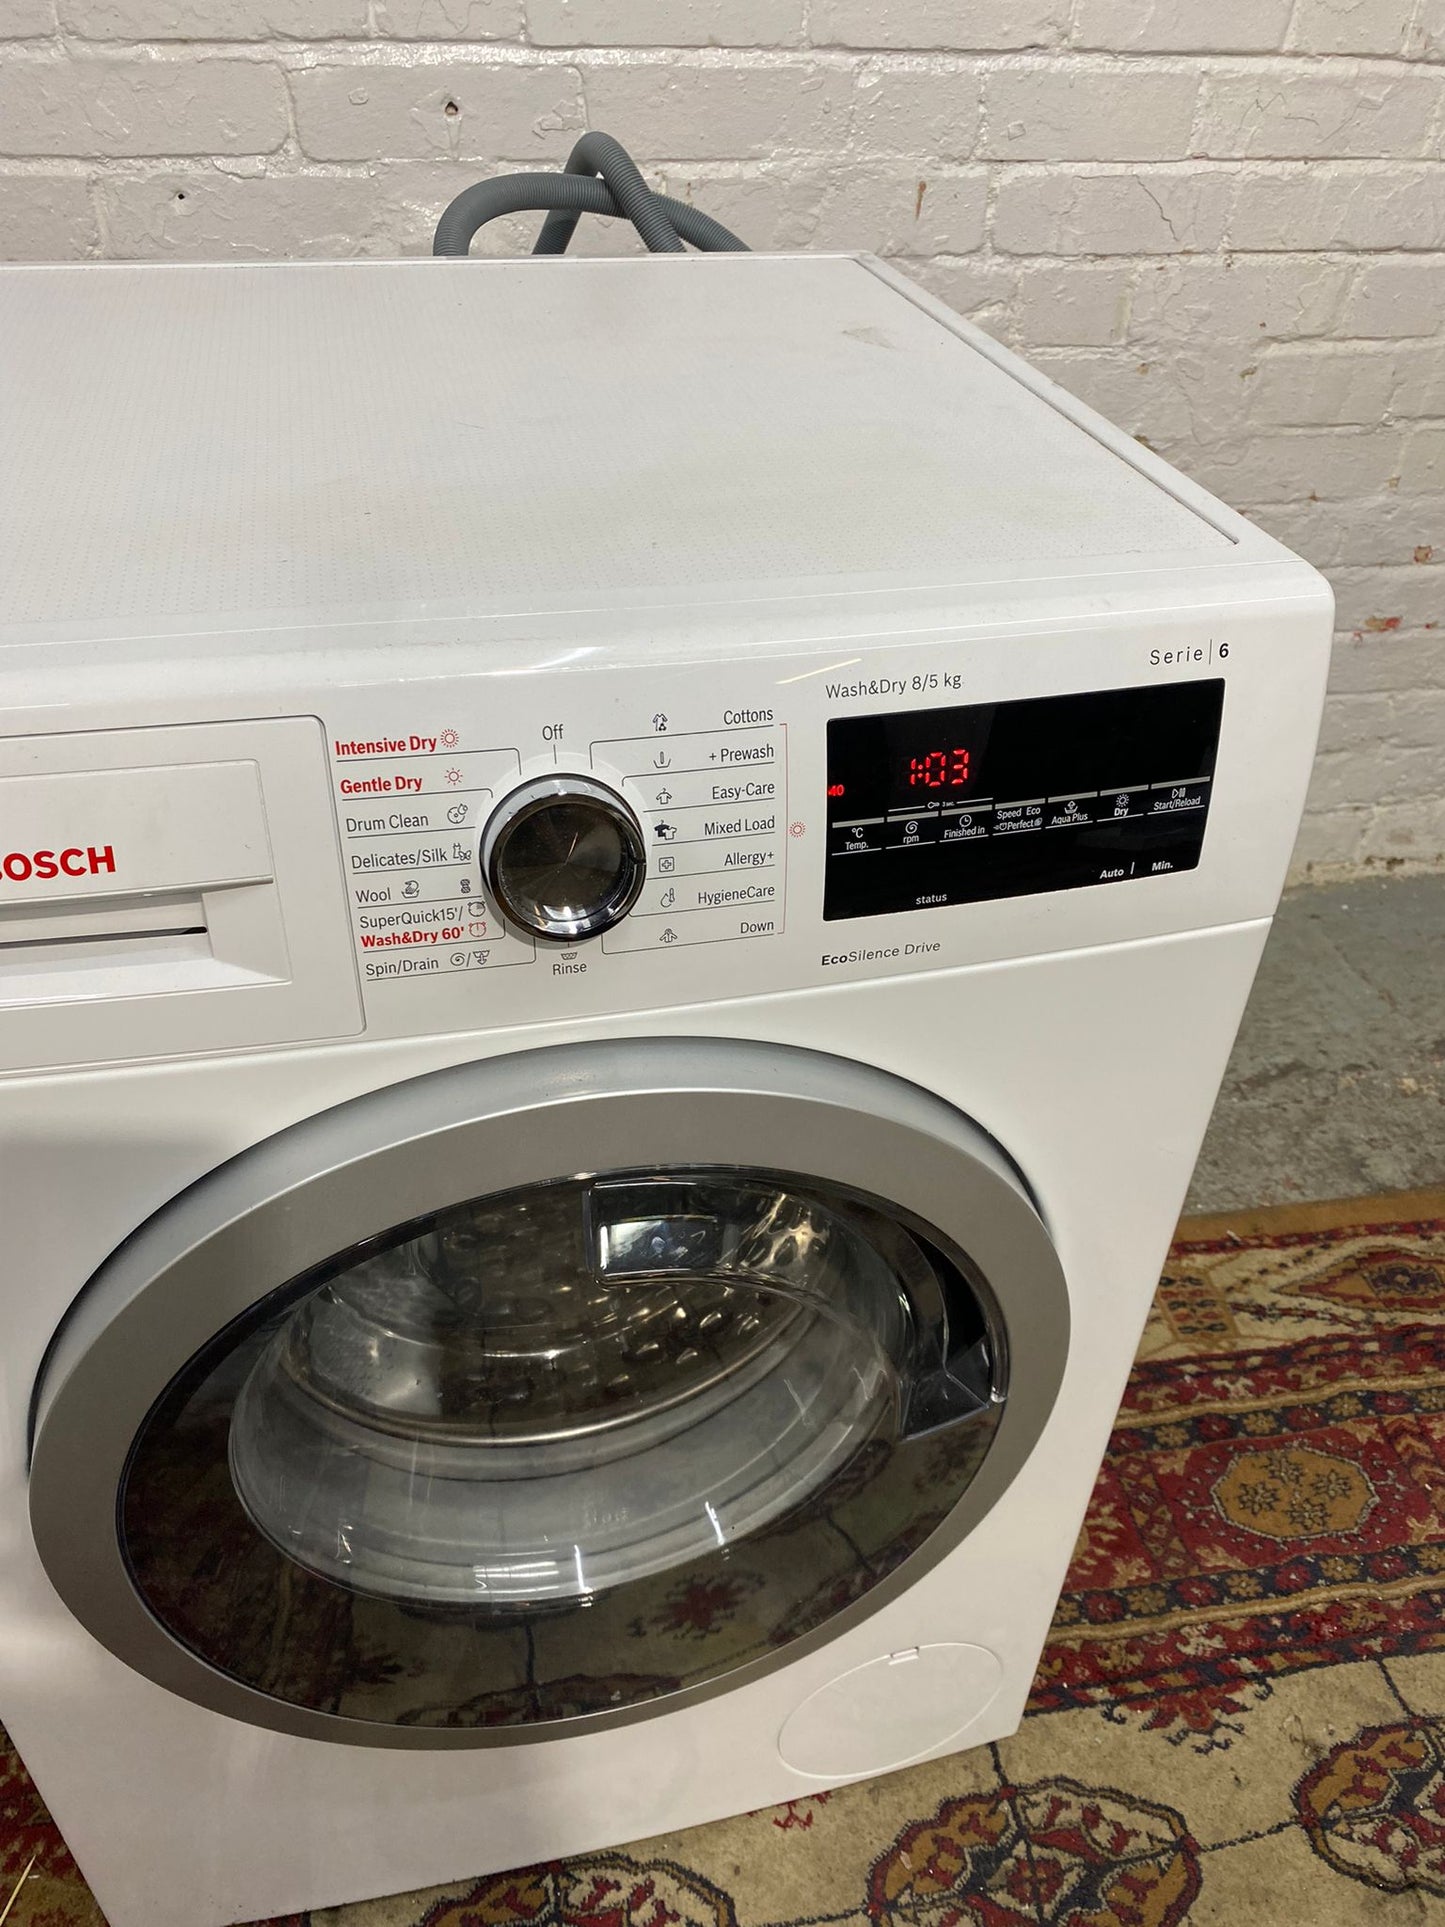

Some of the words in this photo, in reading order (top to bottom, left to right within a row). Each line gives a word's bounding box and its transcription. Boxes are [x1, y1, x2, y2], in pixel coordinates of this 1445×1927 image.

[1150, 646, 1204, 666] Serie
[1218, 642, 1230, 659] 6
[825, 677, 907, 699] Wash&Dry
[912, 674, 939, 692] 8/5
[944, 672, 962, 689] kg
[723, 708, 774, 726] Cottons
[542, 724, 564, 741] Off
[335, 736, 407, 756] Intensive
[409, 733, 437, 753] Dry
[709, 752, 717, 761] +
[721, 744, 774, 763] Prewash
[909, 748, 970, 787] 1:03
[340, 776, 392, 794] Gentle
[395, 776, 423, 793] Dry
[712, 782, 775, 800] Easy-Care
[1153, 796, 1201, 809] Start/Reload
[997, 808, 1022, 820] Speed
[1026, 806, 1041, 816] Eco
[1051, 815, 1071, 826] Aqua
[1072, 812, 1088, 822] Plus
[1114, 807, 1129, 817] Dry
[346, 816, 386, 832] Drum
[389, 812, 429, 829] Clean
[704, 818, 741, 836] Mixed
[745, 815, 775, 832] Load
[1007, 819, 1034, 830] Perfect
[903, 835, 919, 845] rpm
[944, 827, 976, 839] Finished
[977, 826, 985, 835] in
[845, 841, 869, 851] Temp.
[0, 845, 116, 881] OSCH
[351, 847, 448, 869] Delicates/Silk
[723, 851, 775, 867] Allergy+
[1151, 861, 1174, 872] Min.
[1099, 869, 1125, 879] Auto
[355, 887, 391, 903] Wool
[697, 886, 775, 906] HygieneCare
[915, 893, 948, 904] status
[740, 921, 774, 934] Down
[361, 928, 438, 948] Wash&Dry
[442, 926, 464, 940] 60'
[821, 946, 900, 966] EcoSilence
[904, 941, 941, 956] Drive
[365, 957, 439, 977] Spin/Drain
[552, 961, 587, 975] Rinse
